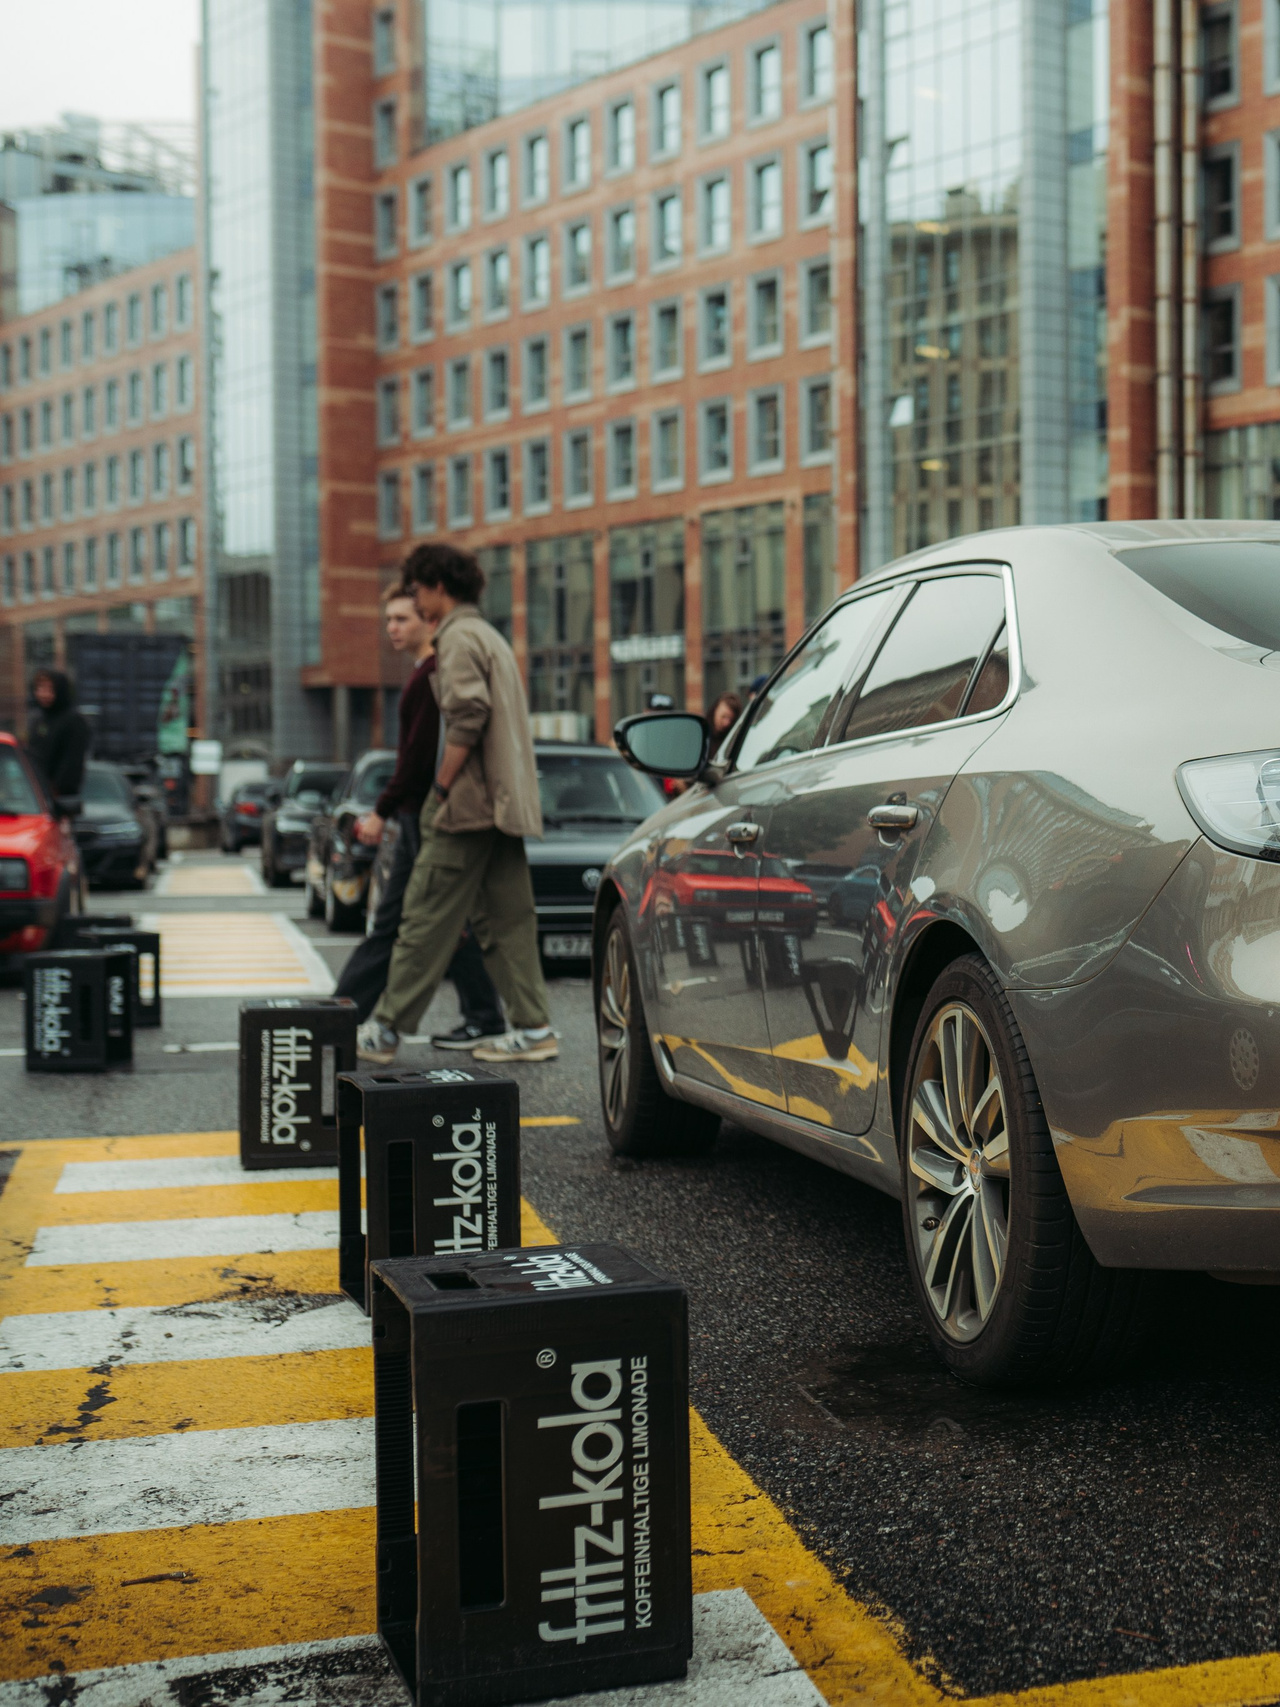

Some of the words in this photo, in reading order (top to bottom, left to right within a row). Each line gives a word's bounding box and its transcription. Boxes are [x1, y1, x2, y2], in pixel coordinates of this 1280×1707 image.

[272, 1026, 313, 1144] fritz-kola
[432, 1122, 483, 1256] itz-kola
[486, 1121, 497, 1181] LIMONADE
[487, 1182, 498, 1250] EINHALTIGE
[631, 1356, 650, 1460] LIMONADE
[538, 1358, 625, 1645] fritz-kola
[633, 1462, 652, 1629] KOFFEINHALTIGE
